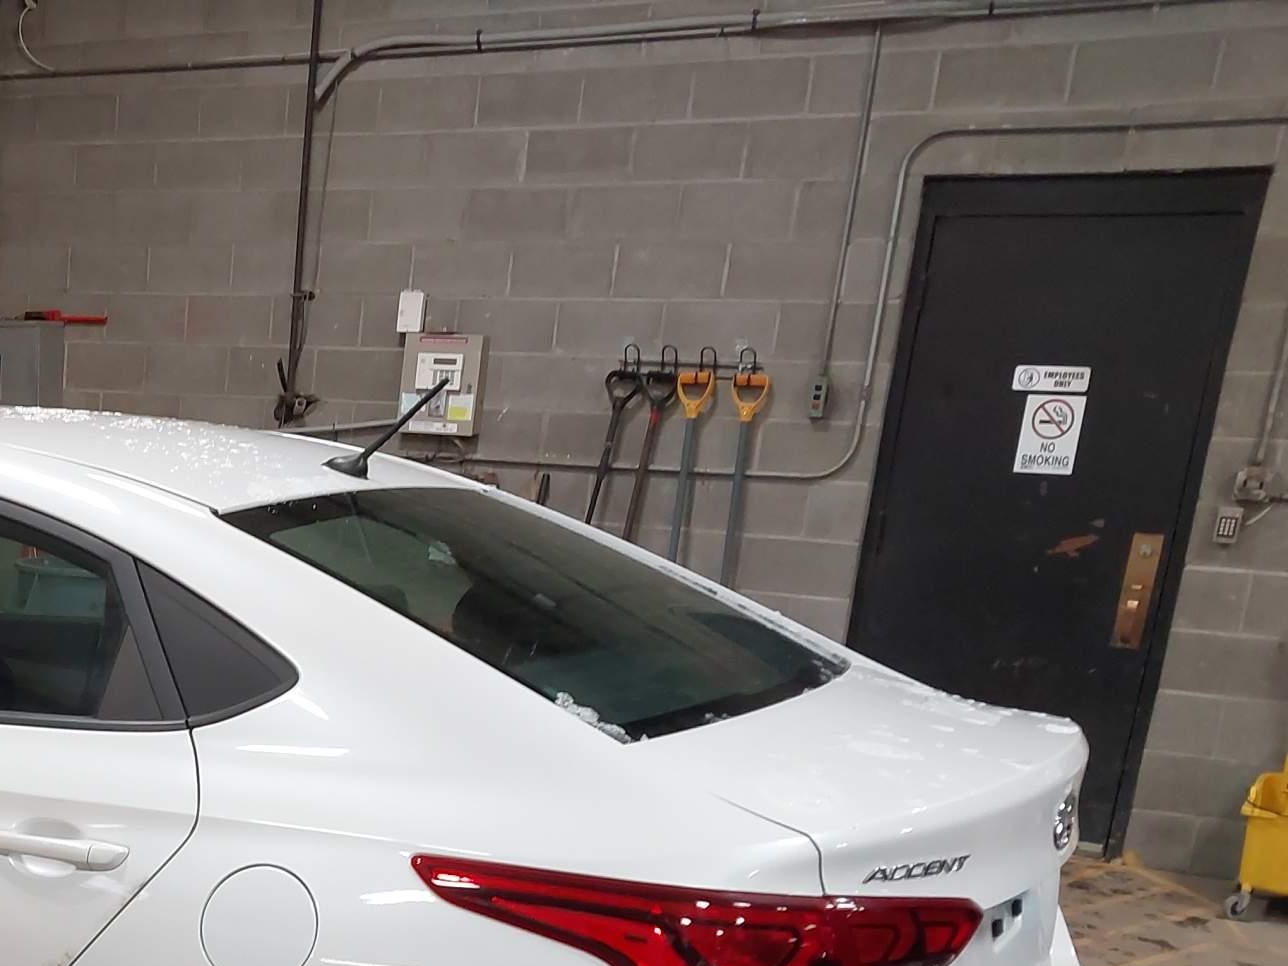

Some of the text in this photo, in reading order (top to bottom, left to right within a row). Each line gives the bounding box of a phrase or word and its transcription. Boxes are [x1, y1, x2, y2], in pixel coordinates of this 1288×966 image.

[1043, 371, 1085, 380] EMPLOYEES
[1053, 380, 1072, 388] ONLY
[1039, 441, 1056, 453] NO
[1020, 454, 1070, 467] SMOKING
[862, 854, 971, 885] ACCENT
